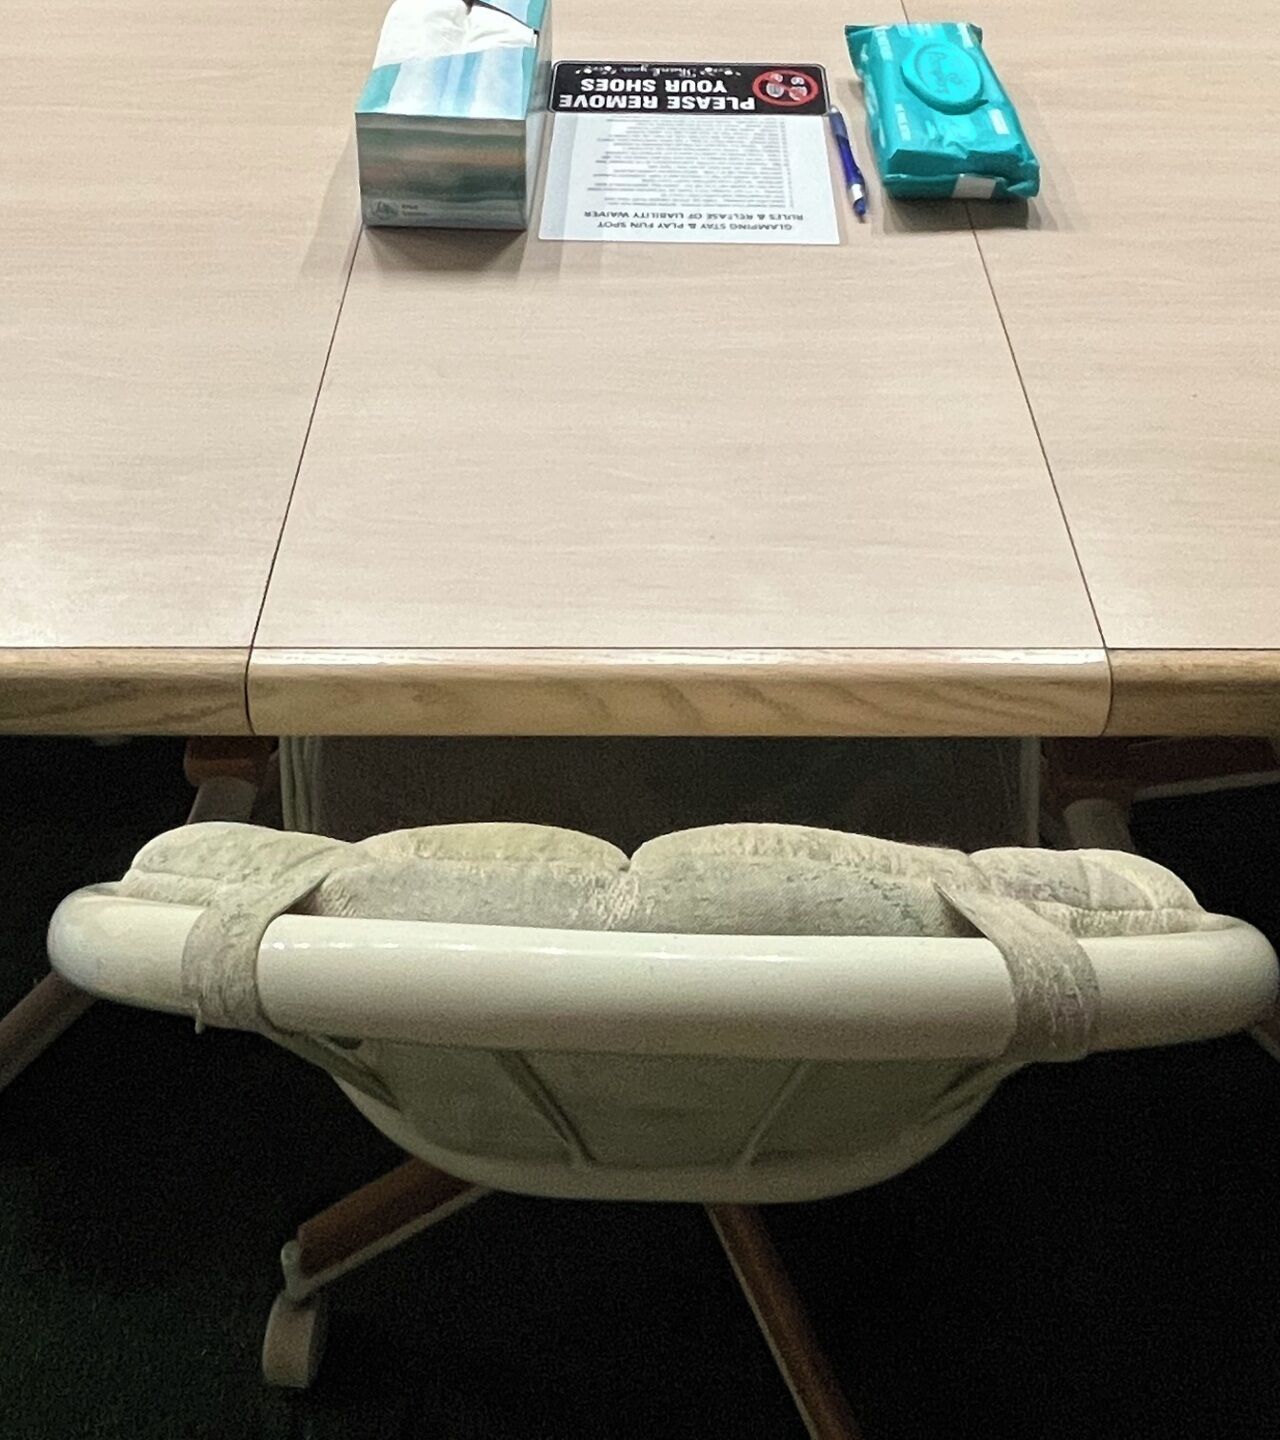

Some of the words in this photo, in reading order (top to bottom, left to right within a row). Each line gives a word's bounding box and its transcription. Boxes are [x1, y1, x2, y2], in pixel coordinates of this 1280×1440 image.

[651, 67, 697, 78] Thank
[580, 78, 657, 92] SHOES
[664, 78, 726, 93] YOUR
[559, 95, 658, 109] REMOVE
[667, 96, 755, 110] PLEASE
[583, 210, 629, 219] WAIVER
[633, 211, 684, 220] LIABILITY
[687, 212, 702, 220] OF
[706, 212, 753, 220] RELEASE
[768, 212, 803, 221] RULES
[729, 223, 793, 231] GLAMPING
